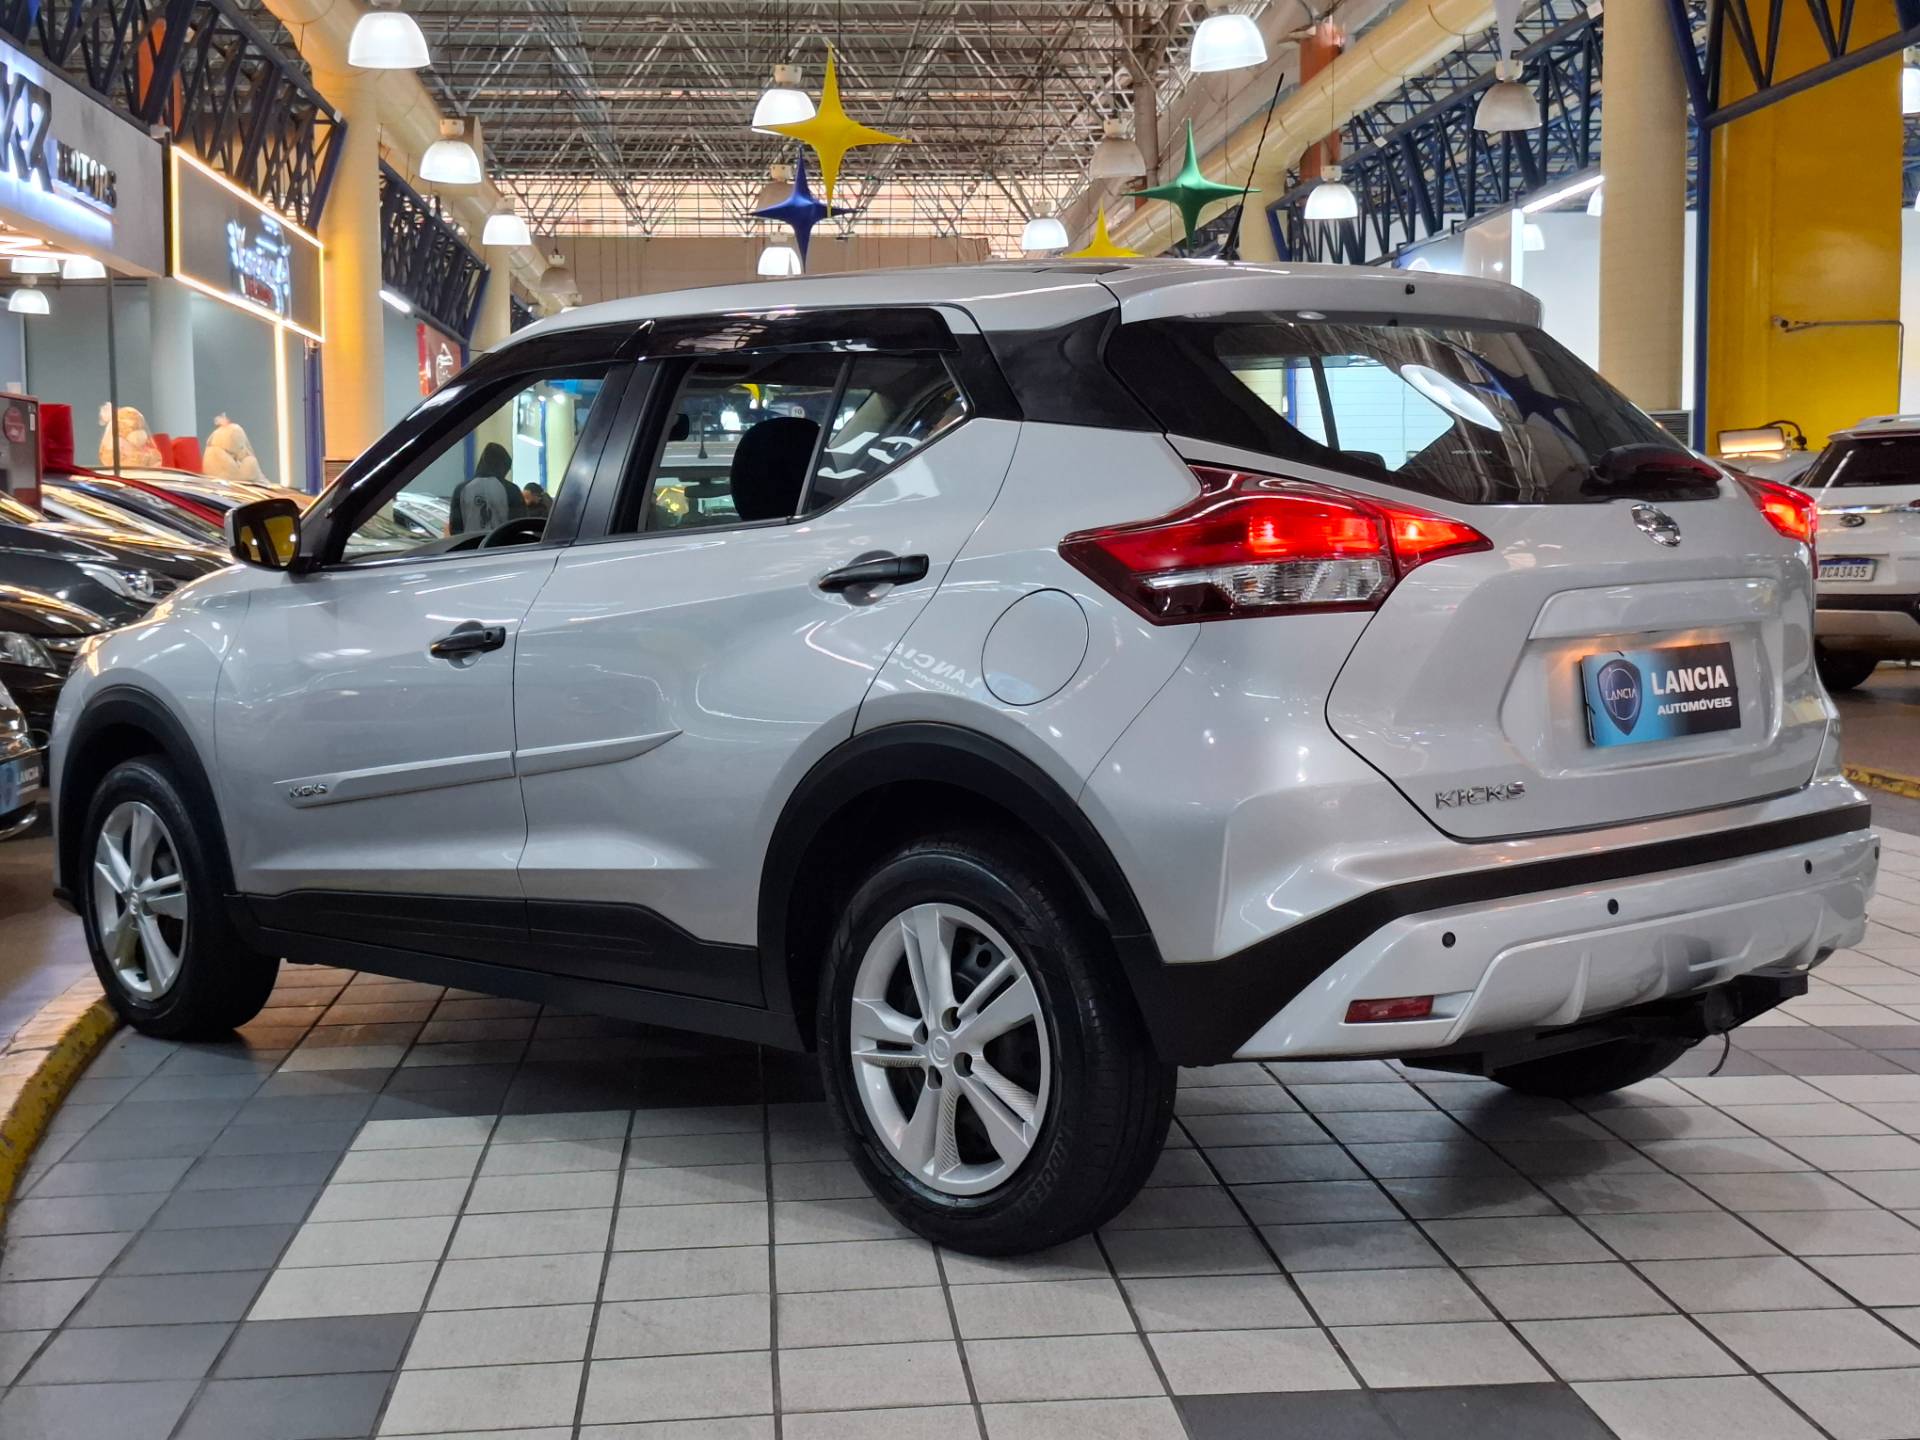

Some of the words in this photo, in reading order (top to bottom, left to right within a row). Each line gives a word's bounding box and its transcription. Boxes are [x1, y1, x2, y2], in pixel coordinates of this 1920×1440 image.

[1651, 664, 1730, 696] LANCIA
[1604, 686, 1638, 701] LANCIA
[1656, 696, 1733, 716] AUTOMÓVEIS
[289, 784, 328, 800] KICKS
[1435, 780, 1525, 809] KICKS
